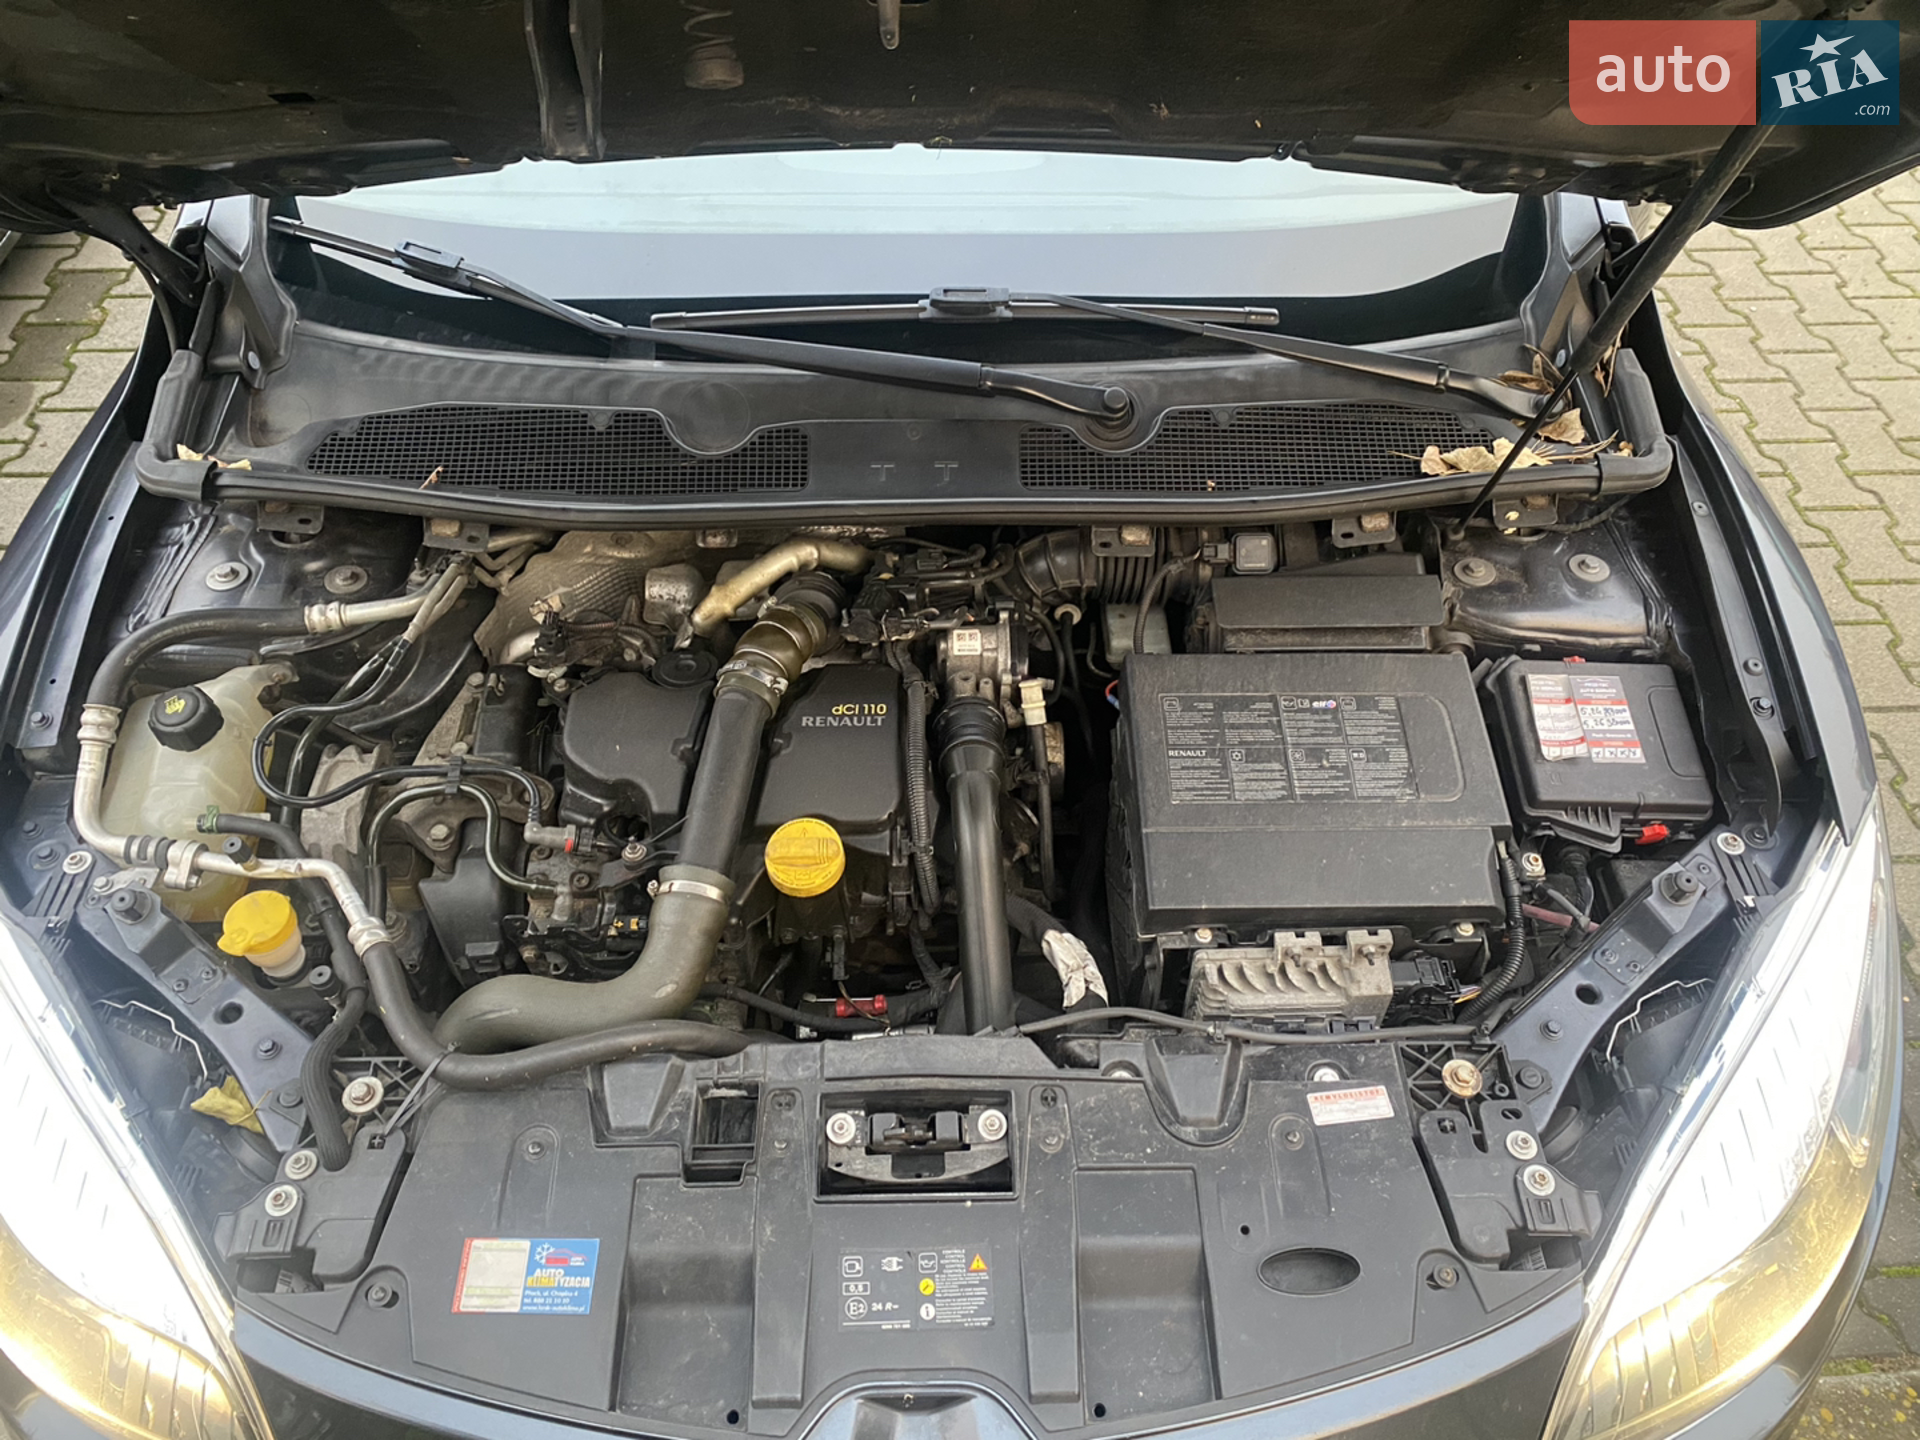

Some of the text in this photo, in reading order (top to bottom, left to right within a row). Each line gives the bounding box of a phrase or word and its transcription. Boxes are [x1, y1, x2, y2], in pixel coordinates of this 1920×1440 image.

[862, 703, 887, 715] 110
[801, 715, 886, 727] RENAULT
[1168, 749, 1207, 757] RENAULT
[534, 1268, 565, 1277] AUTO
[527, 1276, 590, 1288] KLIMATYZACJA
[850, 1302, 864, 1315] E2
[871, 1302, 883, 1311] 24
